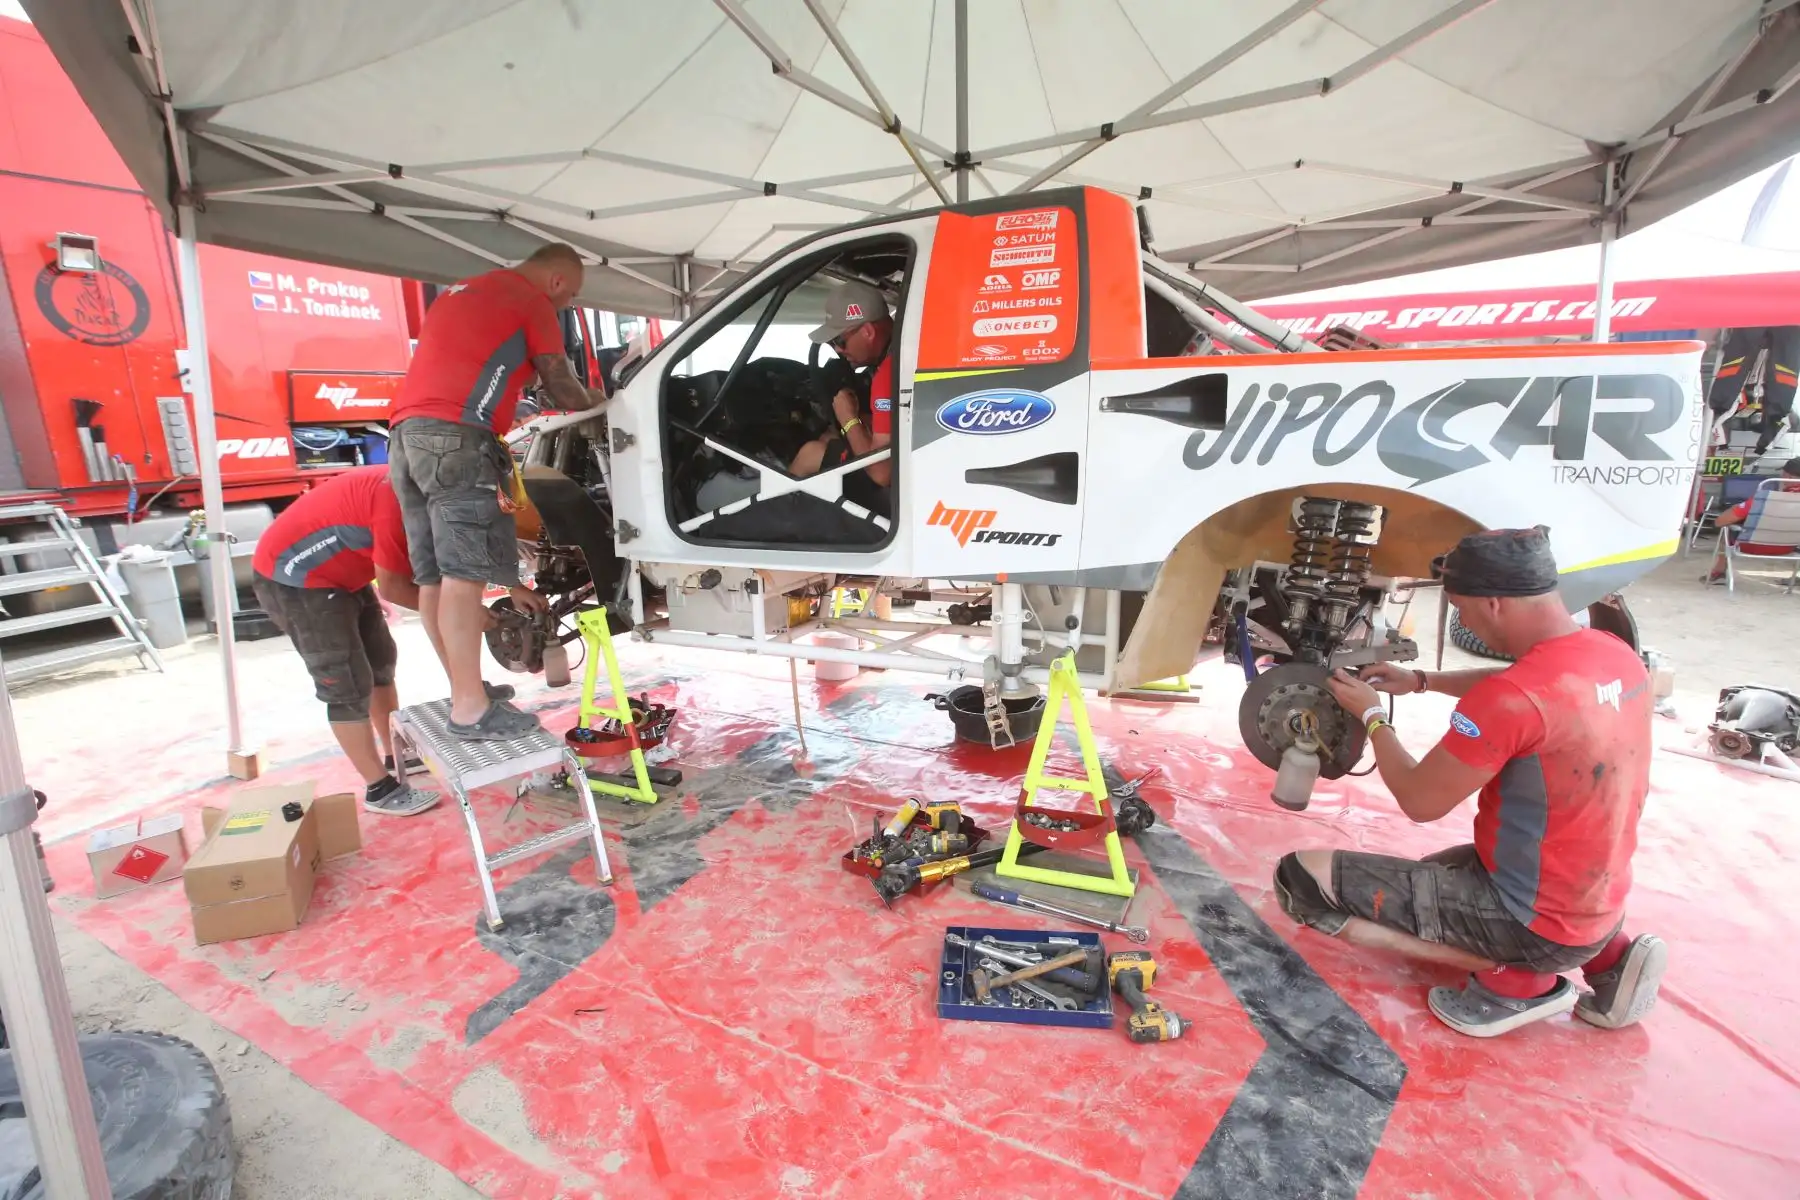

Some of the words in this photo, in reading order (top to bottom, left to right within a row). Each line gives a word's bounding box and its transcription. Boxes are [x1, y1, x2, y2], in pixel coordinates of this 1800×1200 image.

[1010, 232, 1056, 245] SATUM
[1021, 271, 1061, 287] OMP
[277, 273, 302, 292] M.
[306, 277, 370, 303] Prokop
[281, 295, 300, 314] J.
[991, 299, 1037, 310] MILLERS
[1038, 297, 1062, 307] OILS
[994, 320, 1051, 331] ONEBET
[1022, 347, 1061, 356] EDOX
[957, 396, 1033, 429] Ford
[1553, 465, 1685, 485] TRANSPORT
[1703, 459, 1741, 475] 1032
[971, 531, 1062, 547] SPORTS
